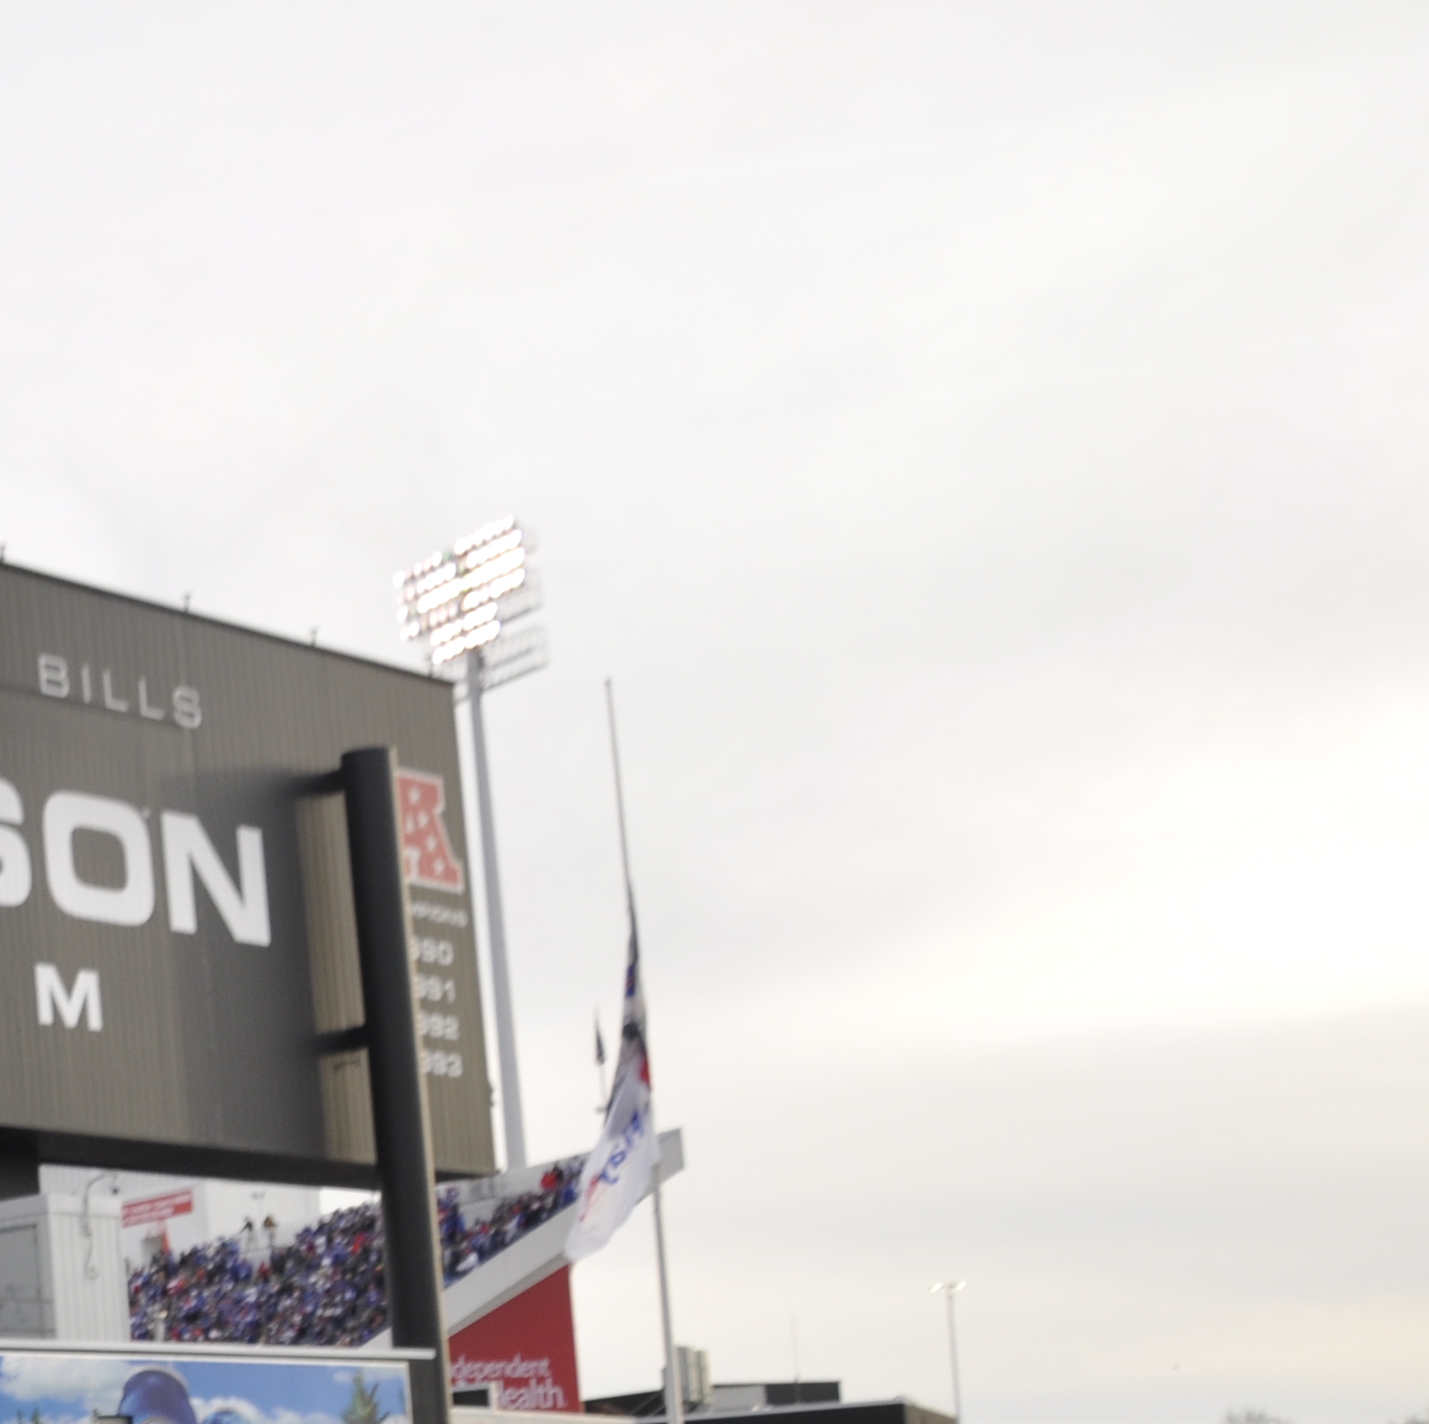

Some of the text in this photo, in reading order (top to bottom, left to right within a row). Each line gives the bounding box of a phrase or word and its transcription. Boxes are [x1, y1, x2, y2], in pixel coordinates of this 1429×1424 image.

[36, 652, 203, 732] BILLS
[408, 934, 455, 968] 990
[414, 972, 456, 1004] 991
[417, 1009, 460, 1041] 992
[421, 1045, 464, 1078] 993
[451, 1353, 552, 1380] dependent
